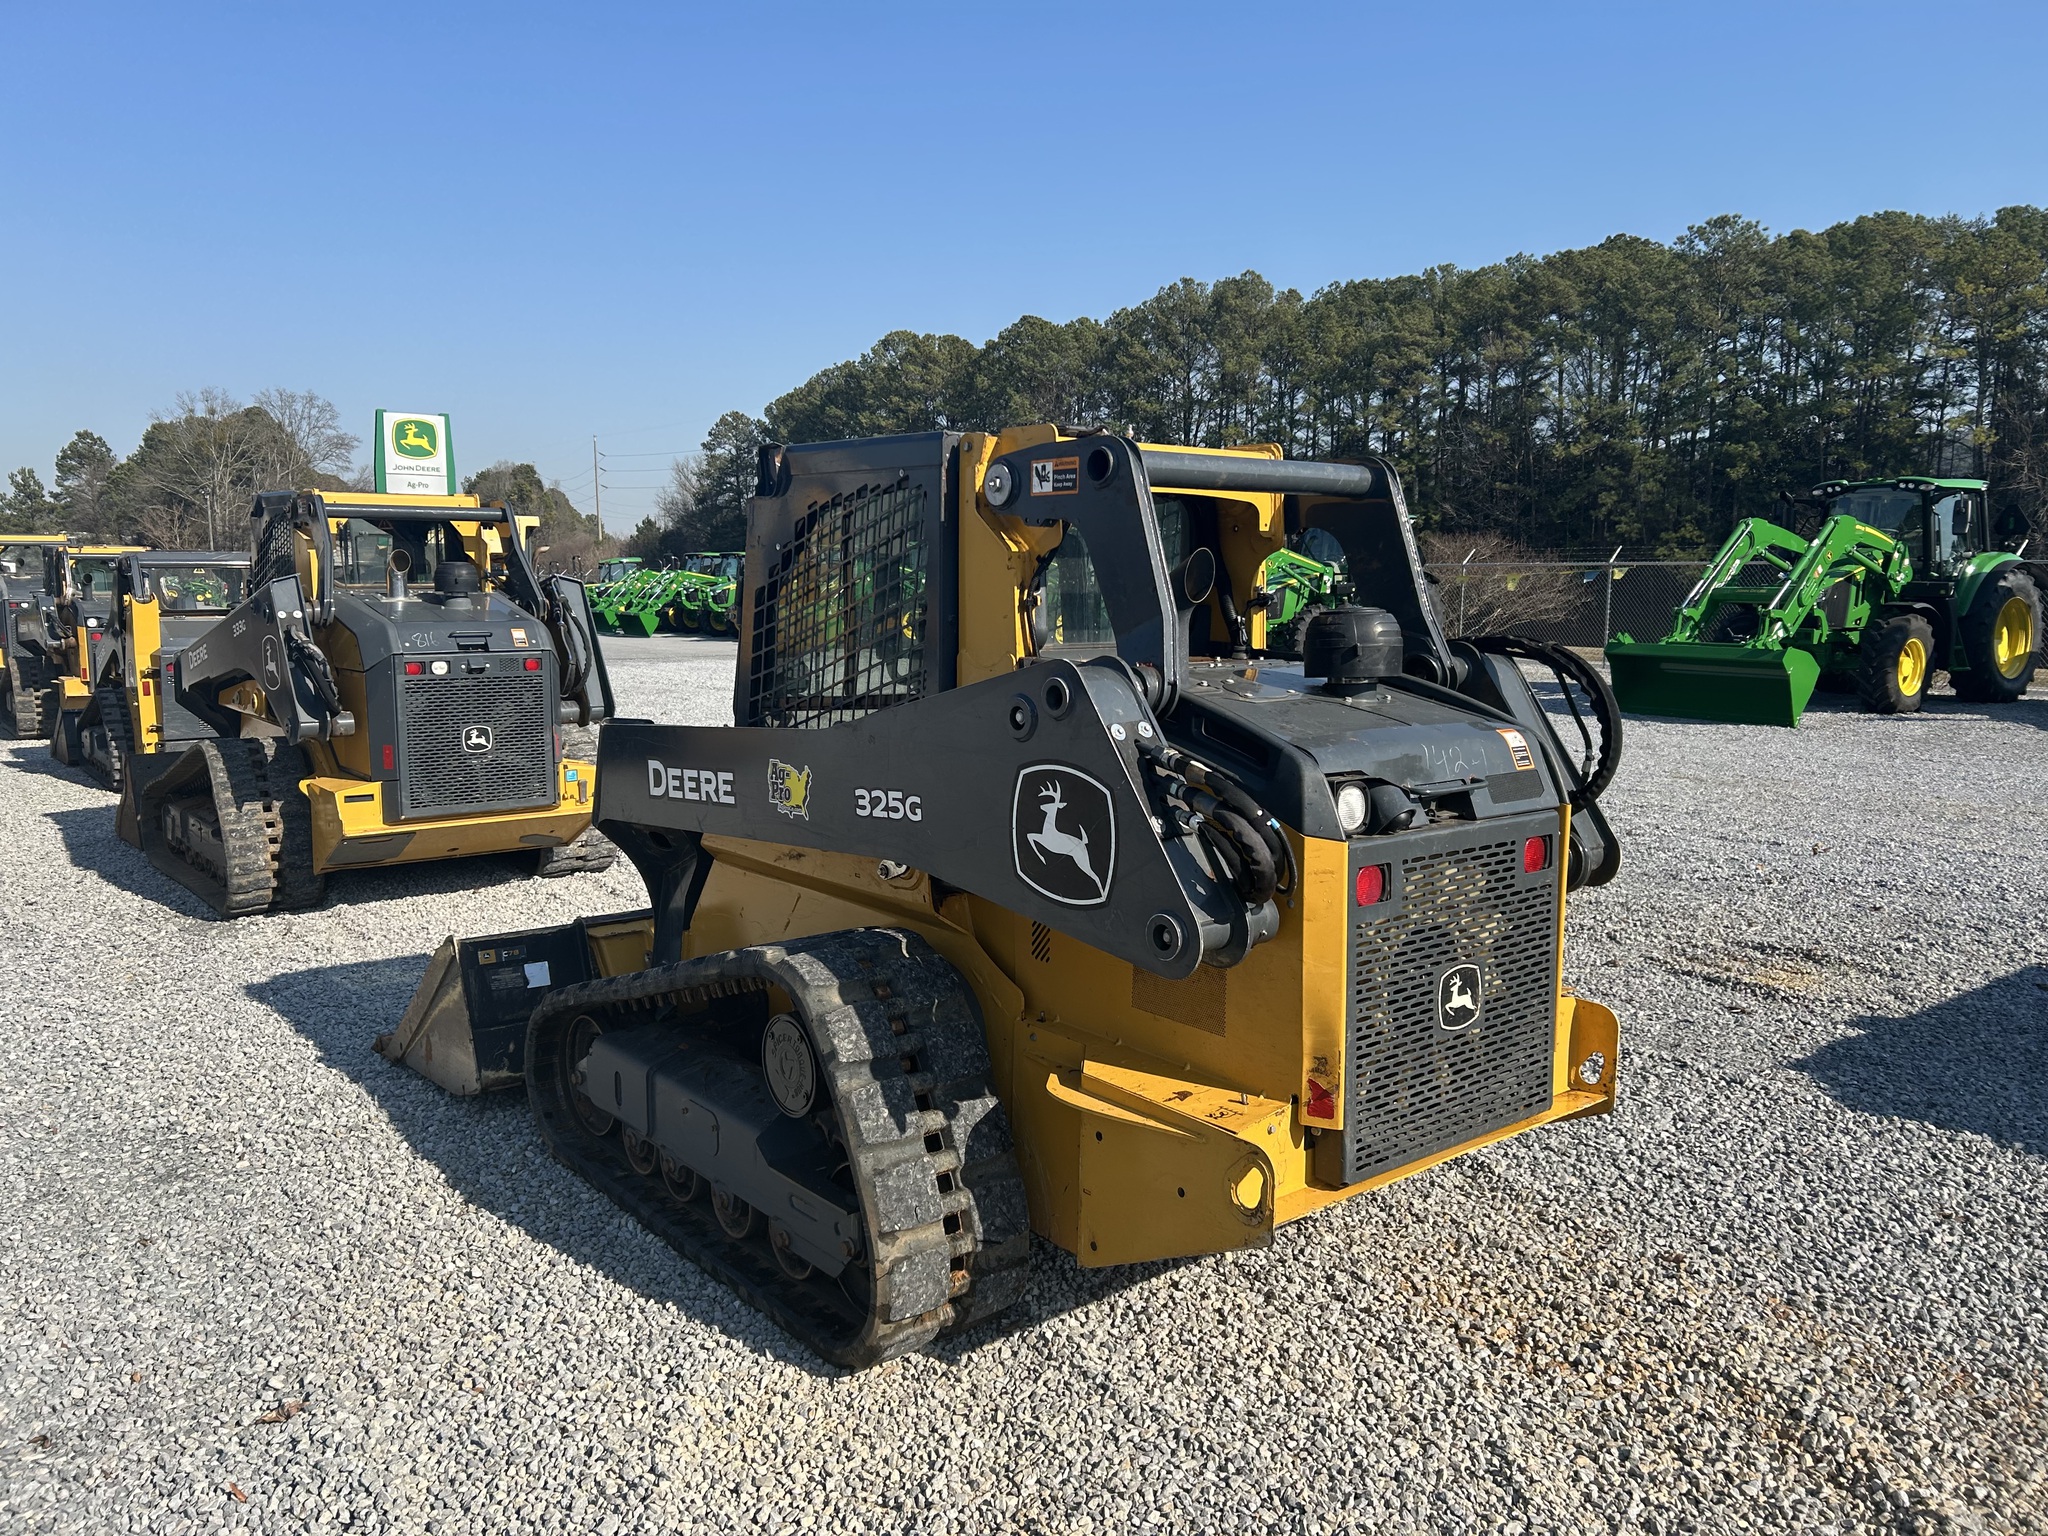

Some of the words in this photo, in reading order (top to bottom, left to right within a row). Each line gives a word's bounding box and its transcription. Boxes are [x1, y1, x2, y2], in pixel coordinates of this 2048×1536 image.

[407, 481, 429, 489] Ag-Pro
[232, 619, 246, 637] 333G
[188, 643, 208, 670] DEERE
[647, 759, 735, 805] DEERE
[770, 780, 791, 803] Pro
[854, 788, 922, 821] 325G
[771, 1033, 792, 1057] SPICER
